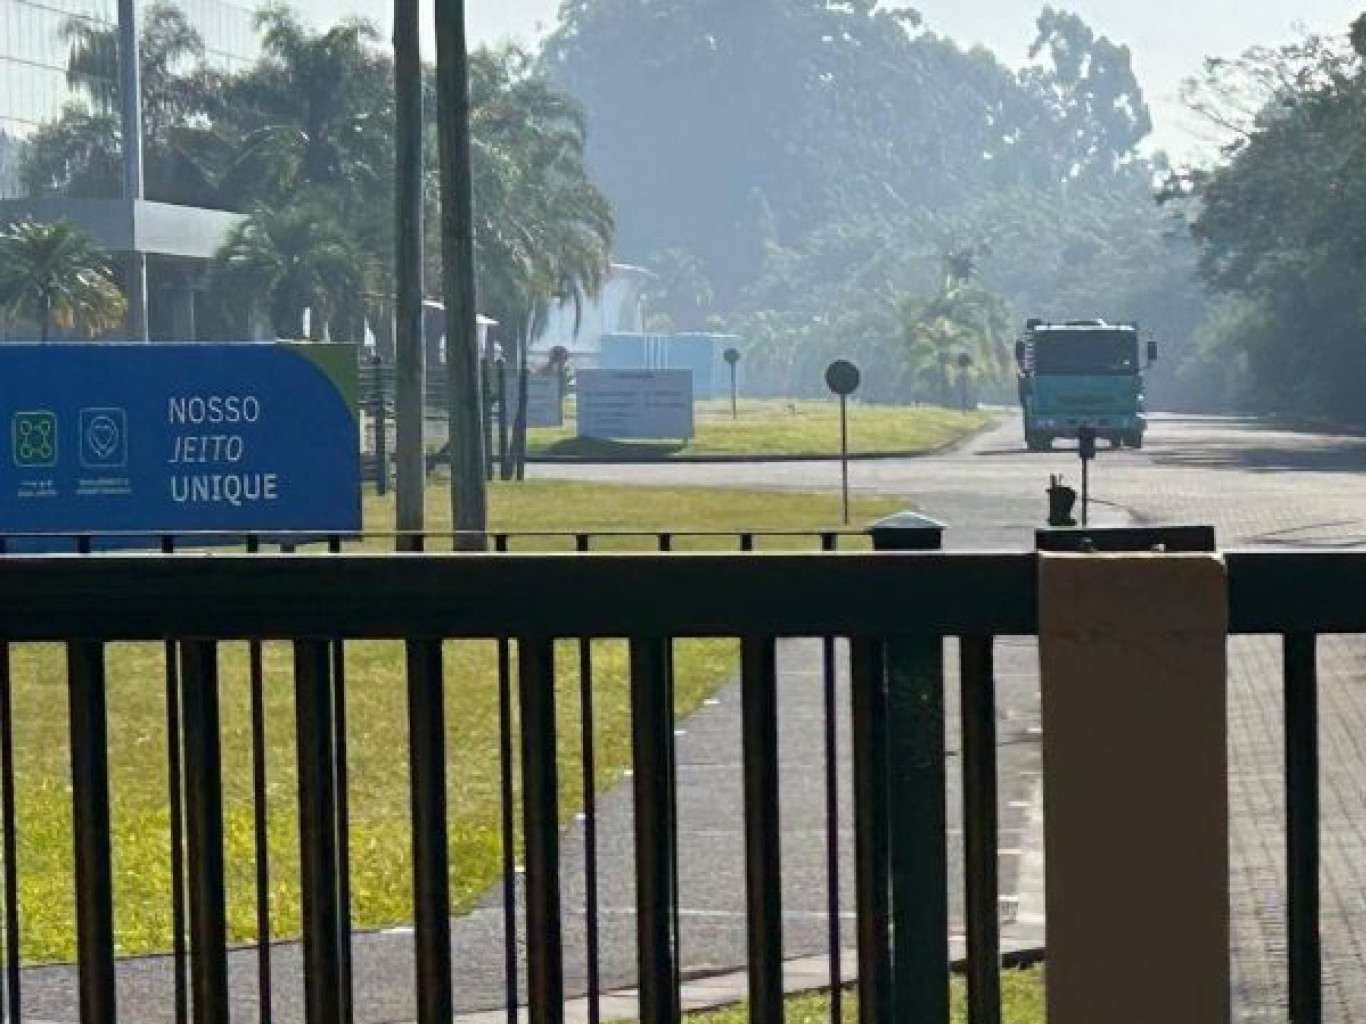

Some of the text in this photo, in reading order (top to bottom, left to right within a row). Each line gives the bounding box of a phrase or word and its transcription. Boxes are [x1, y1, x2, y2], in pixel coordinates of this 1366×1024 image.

[167, 396, 261, 425] NOSSO
[168, 436, 243, 463] JEITO
[171, 473, 279, 506] UNIQUE
